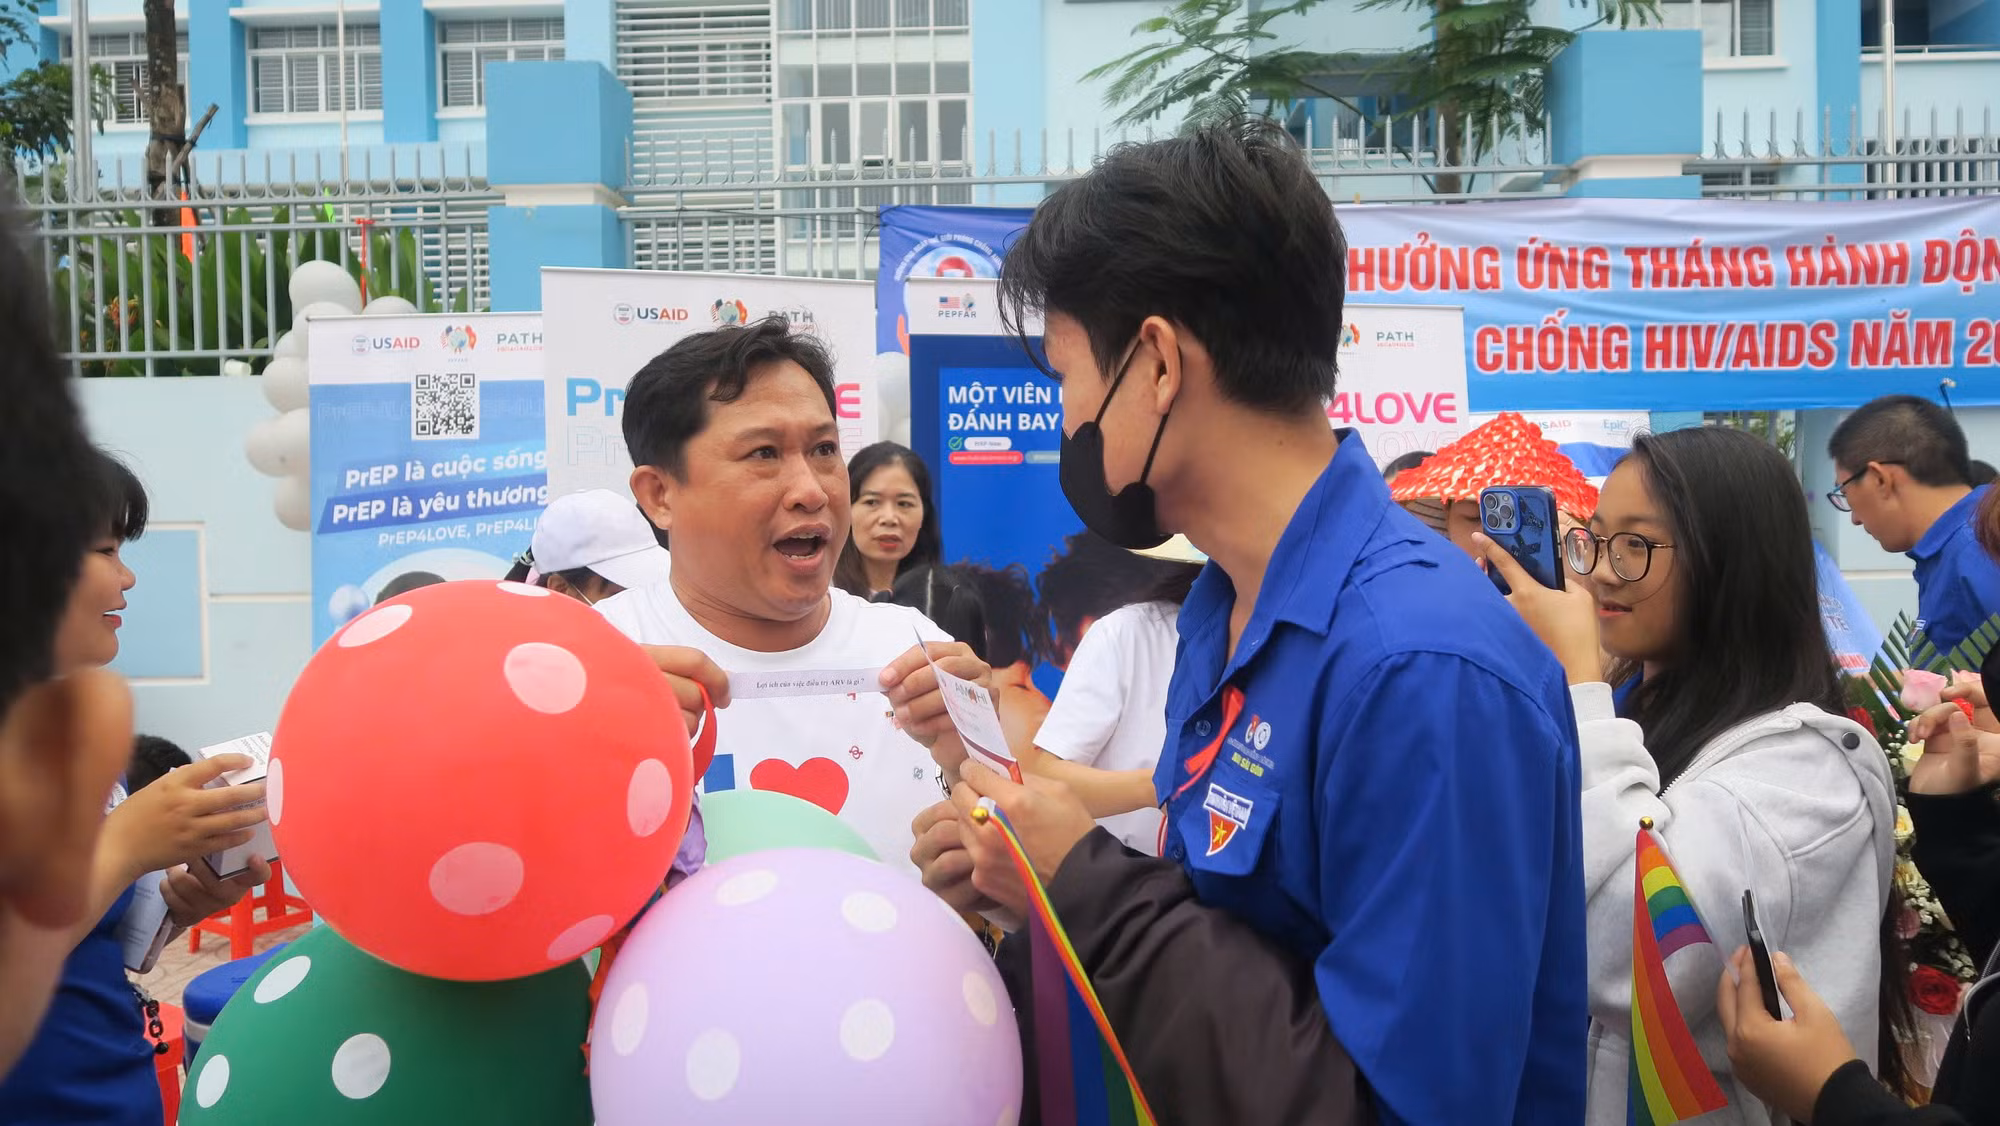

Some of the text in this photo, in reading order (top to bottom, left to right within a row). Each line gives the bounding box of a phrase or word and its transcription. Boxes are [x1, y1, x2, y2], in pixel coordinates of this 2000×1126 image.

[1347, 231, 1502, 291] HƯỞNG
[1516, 237, 1611, 290] ỨNG
[1624, 237, 1773, 288] THÁNG
[1785, 235, 1909, 287] HÀNH
[637, 307, 689, 321] USAID
[938, 310, 977, 318] PEPFAR
[372, 336, 420, 349] USAID
[497, 332, 543, 345] PATH
[1376, 331, 1415, 342] PATH
[1475, 309, 1630, 372] CHỐNG
[1644, 321, 1837, 369] HIV/AIDS
[1850, 310, 1954, 366] NĂM
[948, 381, 998, 408] MỘT
[1002, 381, 1052, 405] VIÊN
[948, 408, 1060, 431] ĐÁNH BAY
[344, 446, 548, 490] PrEP là cuộc sống
[332, 484, 549, 525] PrEP là yêu thương
[378, 524, 471, 547] PrEP4LOVE,
